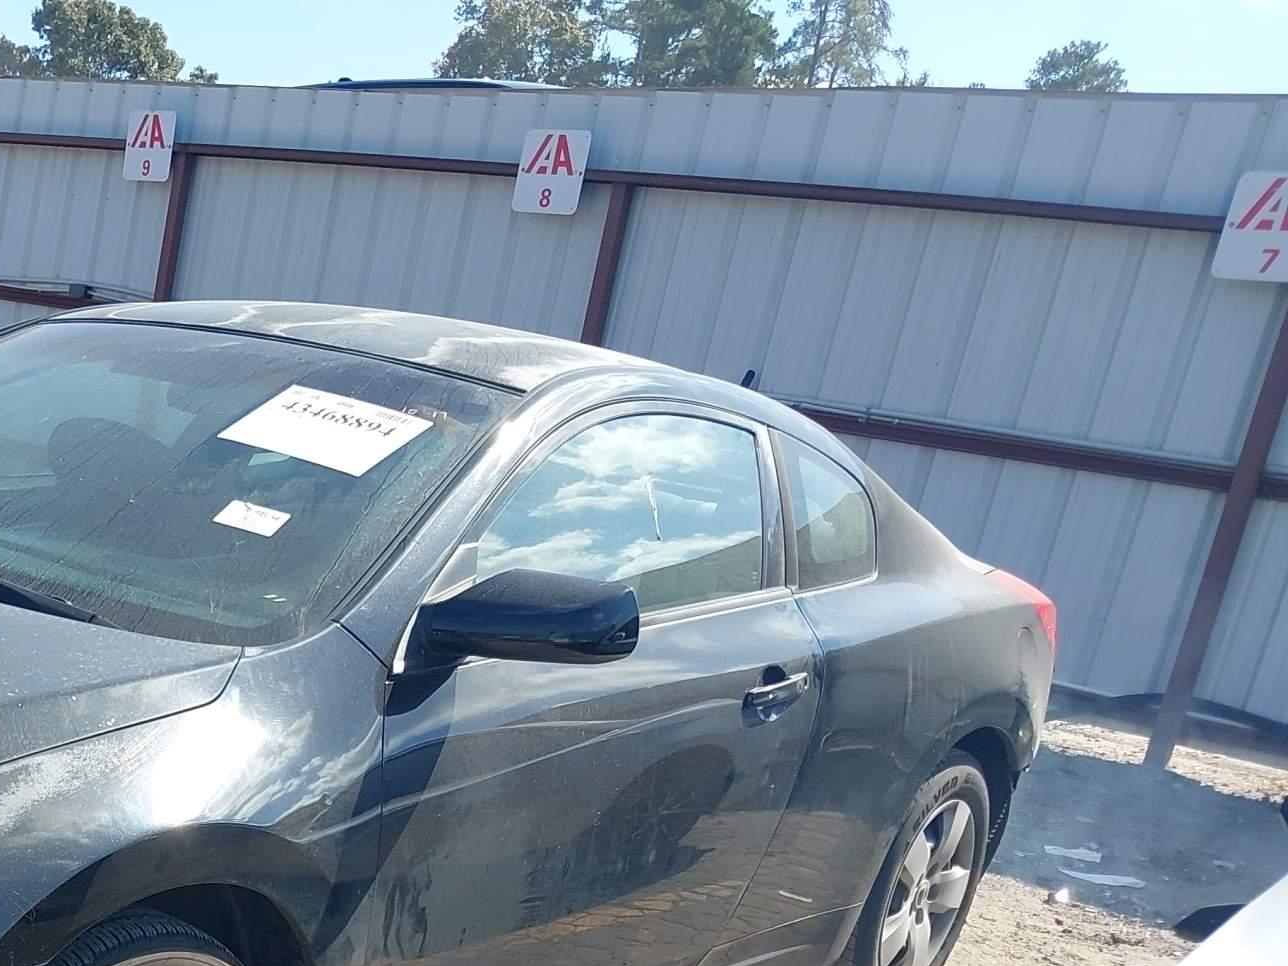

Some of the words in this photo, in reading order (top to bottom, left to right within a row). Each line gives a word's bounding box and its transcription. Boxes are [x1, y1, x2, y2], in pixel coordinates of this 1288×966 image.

[142, 159, 151, 176] 9
[539, 188, 552, 208] 8
[1258, 248, 1281, 274] 7
[281, 401, 397, 437] 43468894
